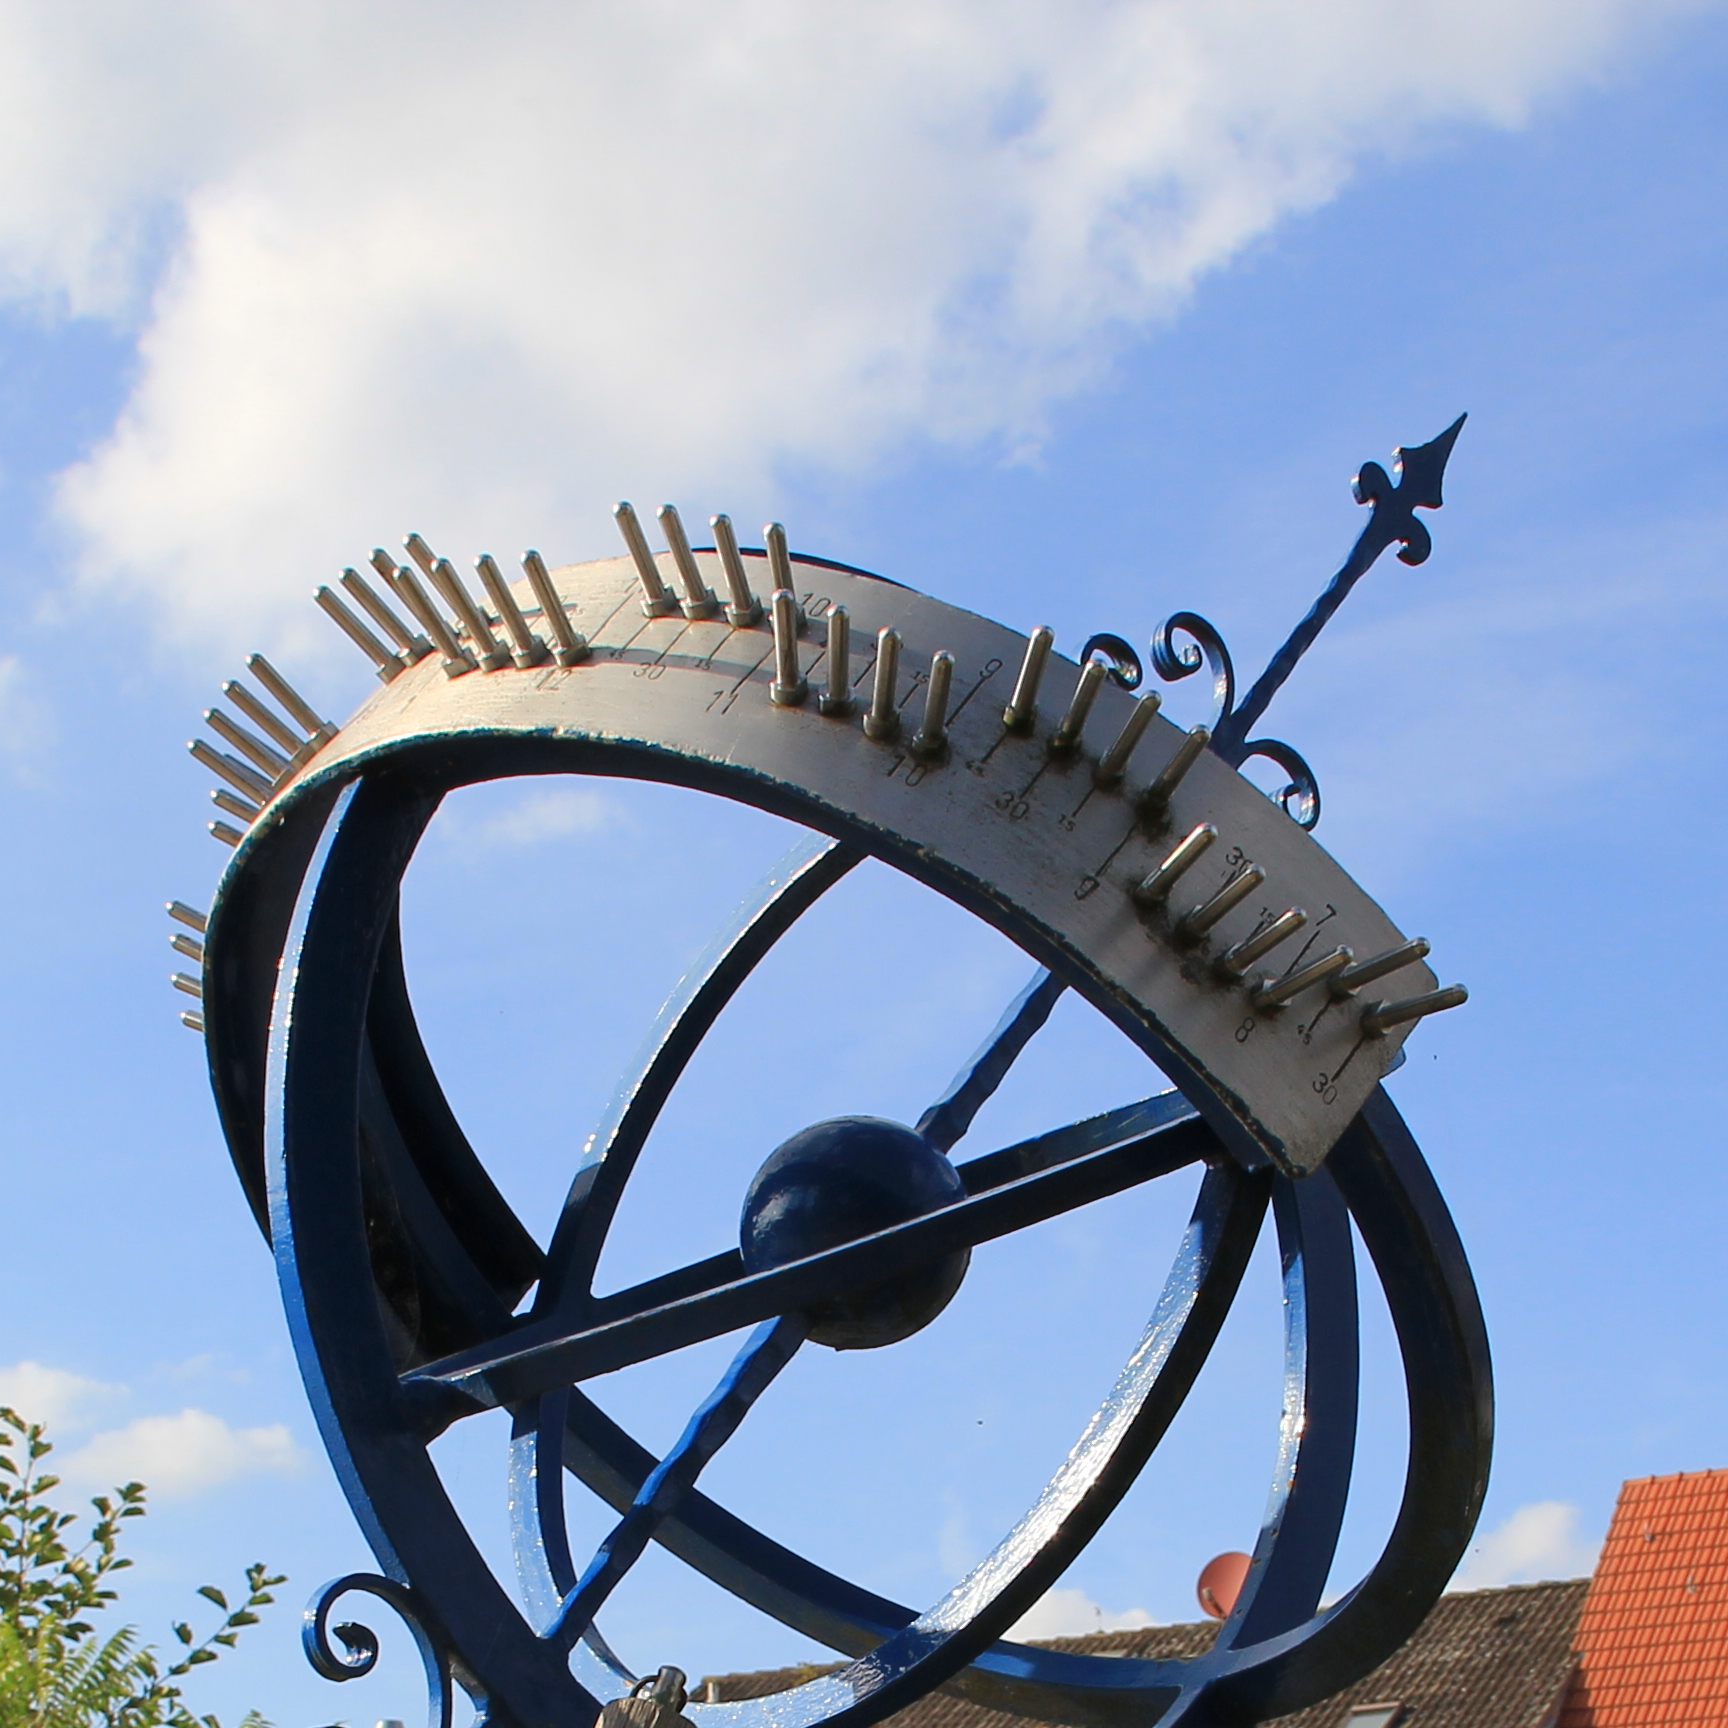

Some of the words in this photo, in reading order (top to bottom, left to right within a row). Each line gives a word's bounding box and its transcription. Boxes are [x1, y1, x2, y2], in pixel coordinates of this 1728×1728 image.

[802, 592, 832, 618] 10
[633, 662, 667, 680] 30
[910, 670, 930, 685] 15
[979, 658, 1004, 681] 9
[706, 690, 739, 715] 11
[887, 754, 928, 787] 10
[995, 791, 1030, 820] 30
[1058, 813, 1076, 832] 15
[1316, 903, 1337, 927] 7
[1235, 1017, 1255, 1043] 8
[1312, 1072, 1338, 1105] 30
